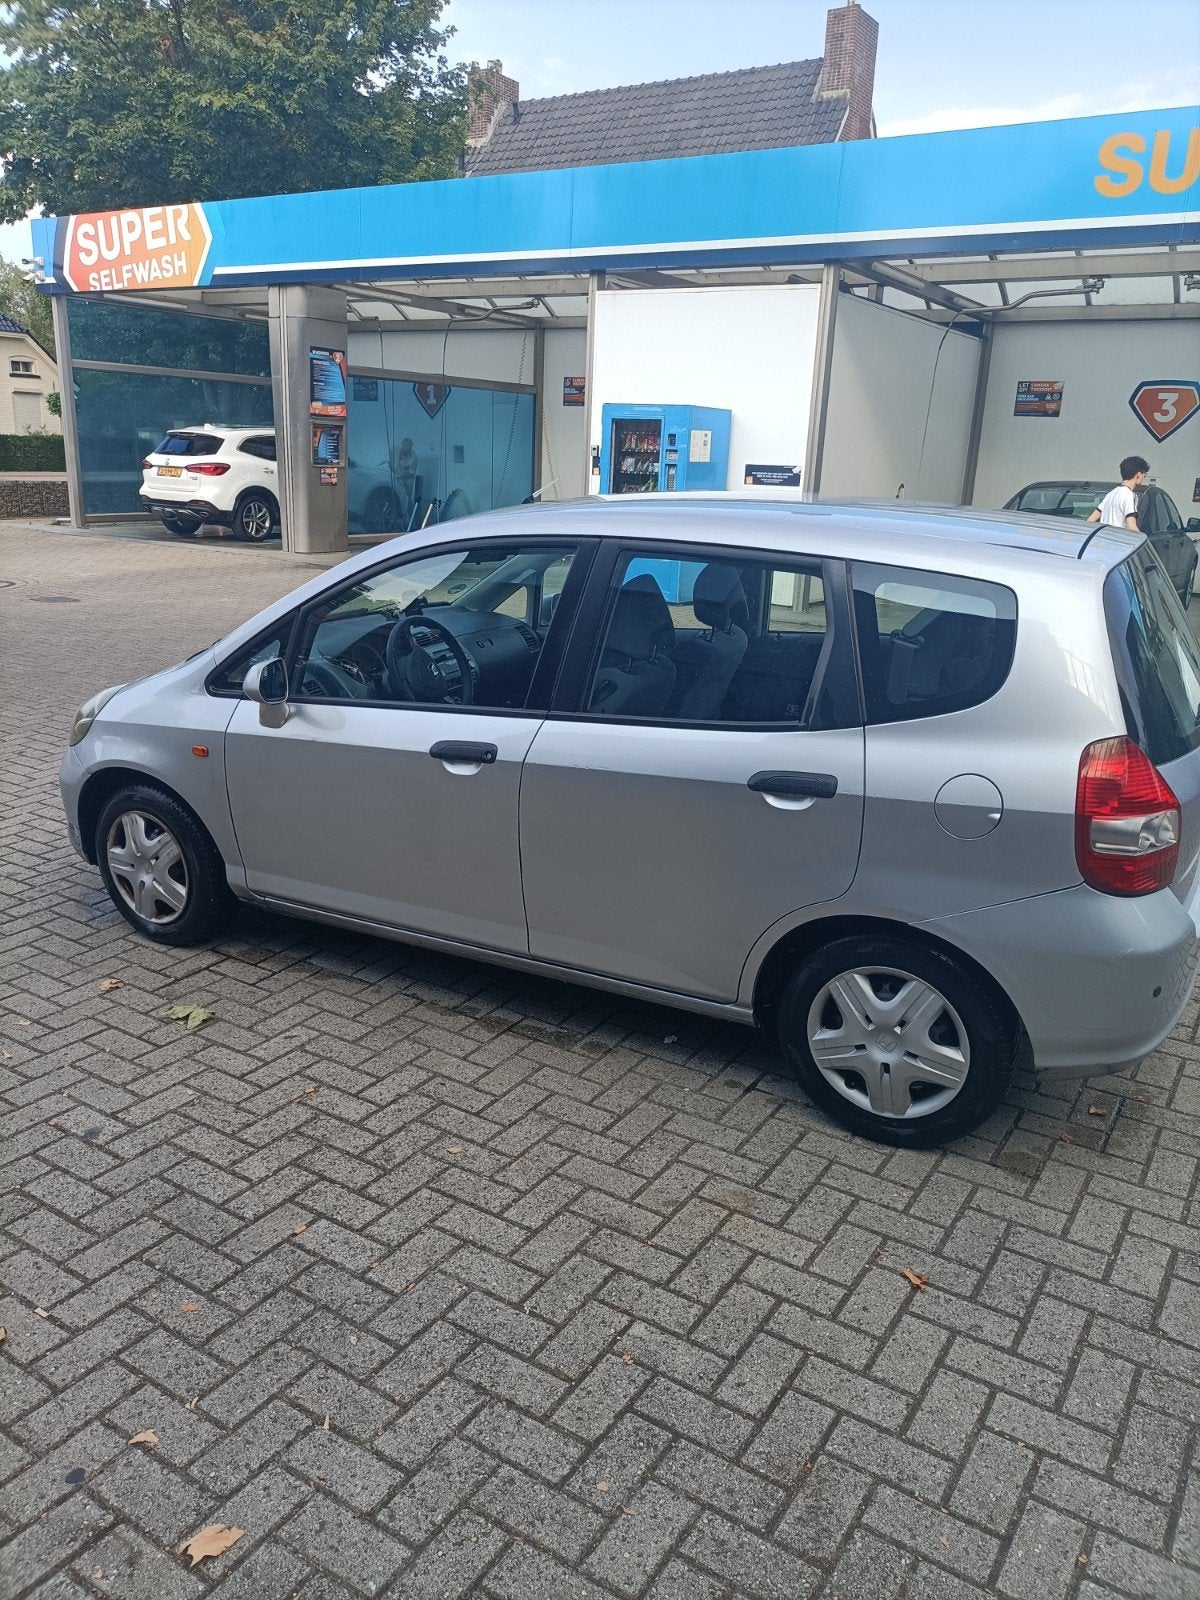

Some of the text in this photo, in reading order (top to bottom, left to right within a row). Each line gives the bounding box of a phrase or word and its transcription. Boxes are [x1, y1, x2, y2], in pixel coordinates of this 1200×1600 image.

[76, 203, 193, 266] SUPER
[88, 251, 188, 291] SELFWASH
[426, 384, 437, 405] 1
[1153, 392, 1179, 423] 3
